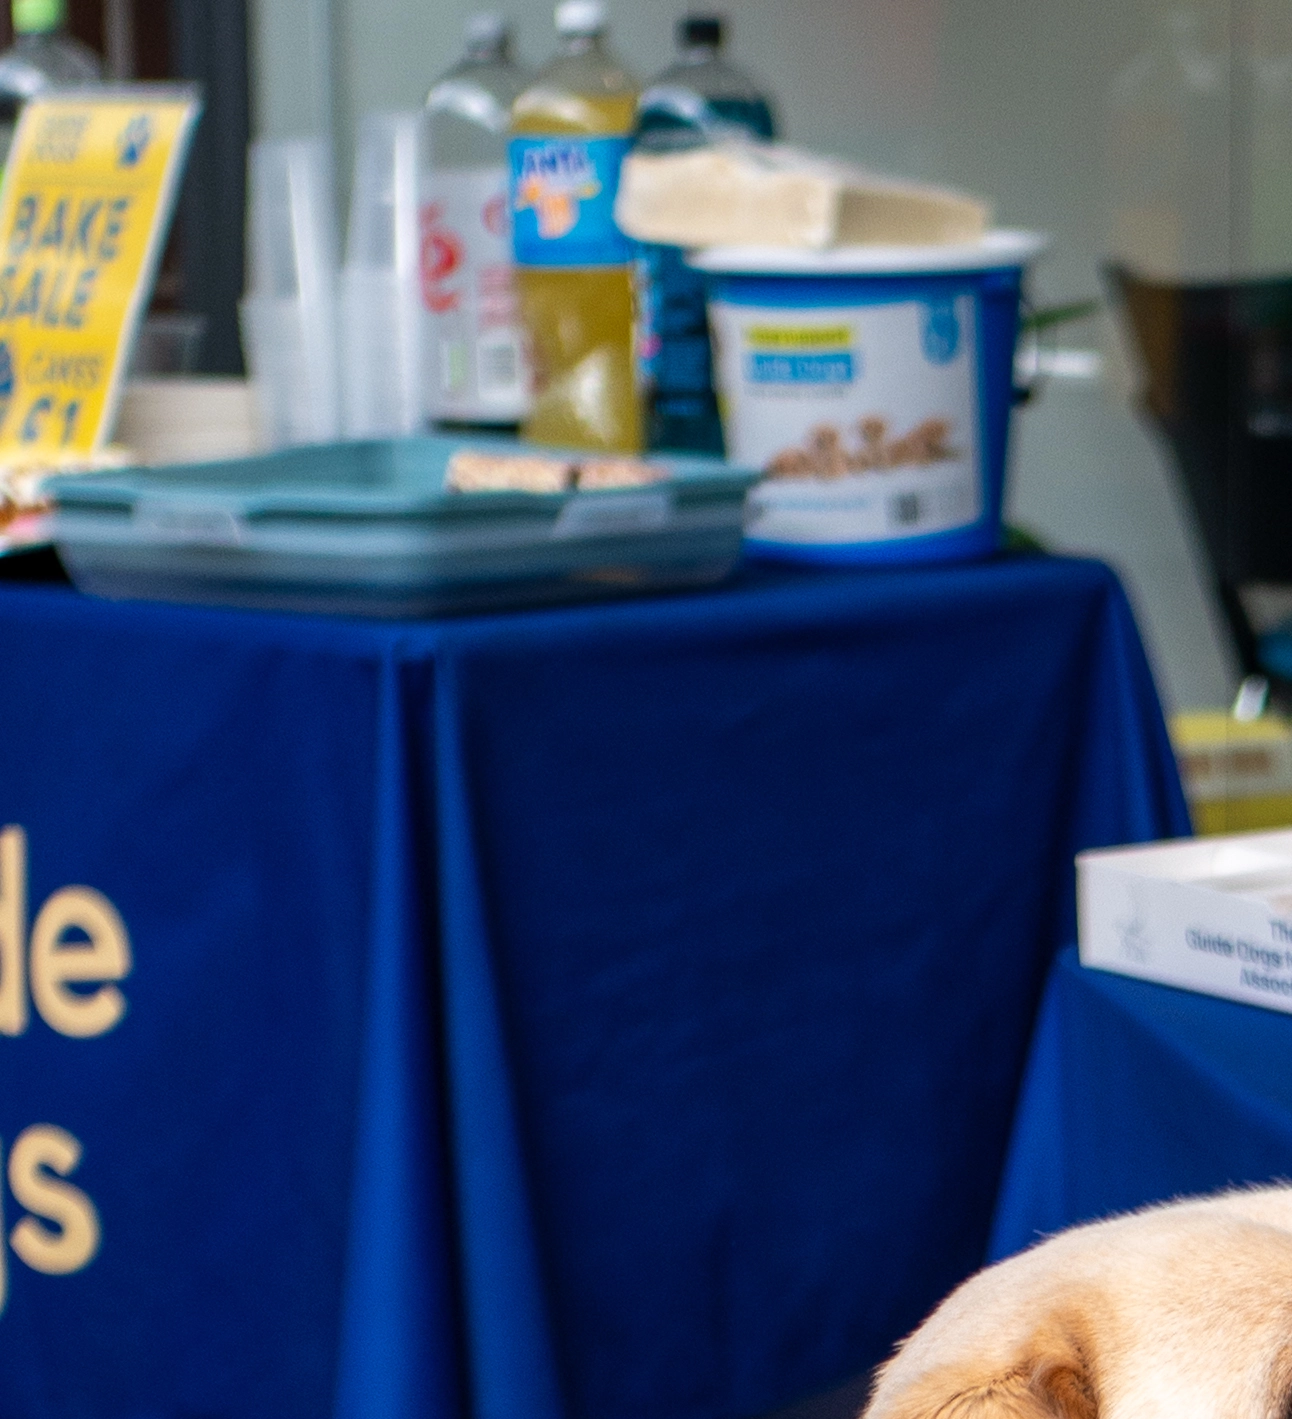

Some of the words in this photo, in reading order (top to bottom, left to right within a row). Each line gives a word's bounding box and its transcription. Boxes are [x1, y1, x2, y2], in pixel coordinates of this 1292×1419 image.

[8, 196, 129, 260] BAKE
[1185, 927, 1234, 955] Guide
[1236, 938, 1283, 969] Dogs
